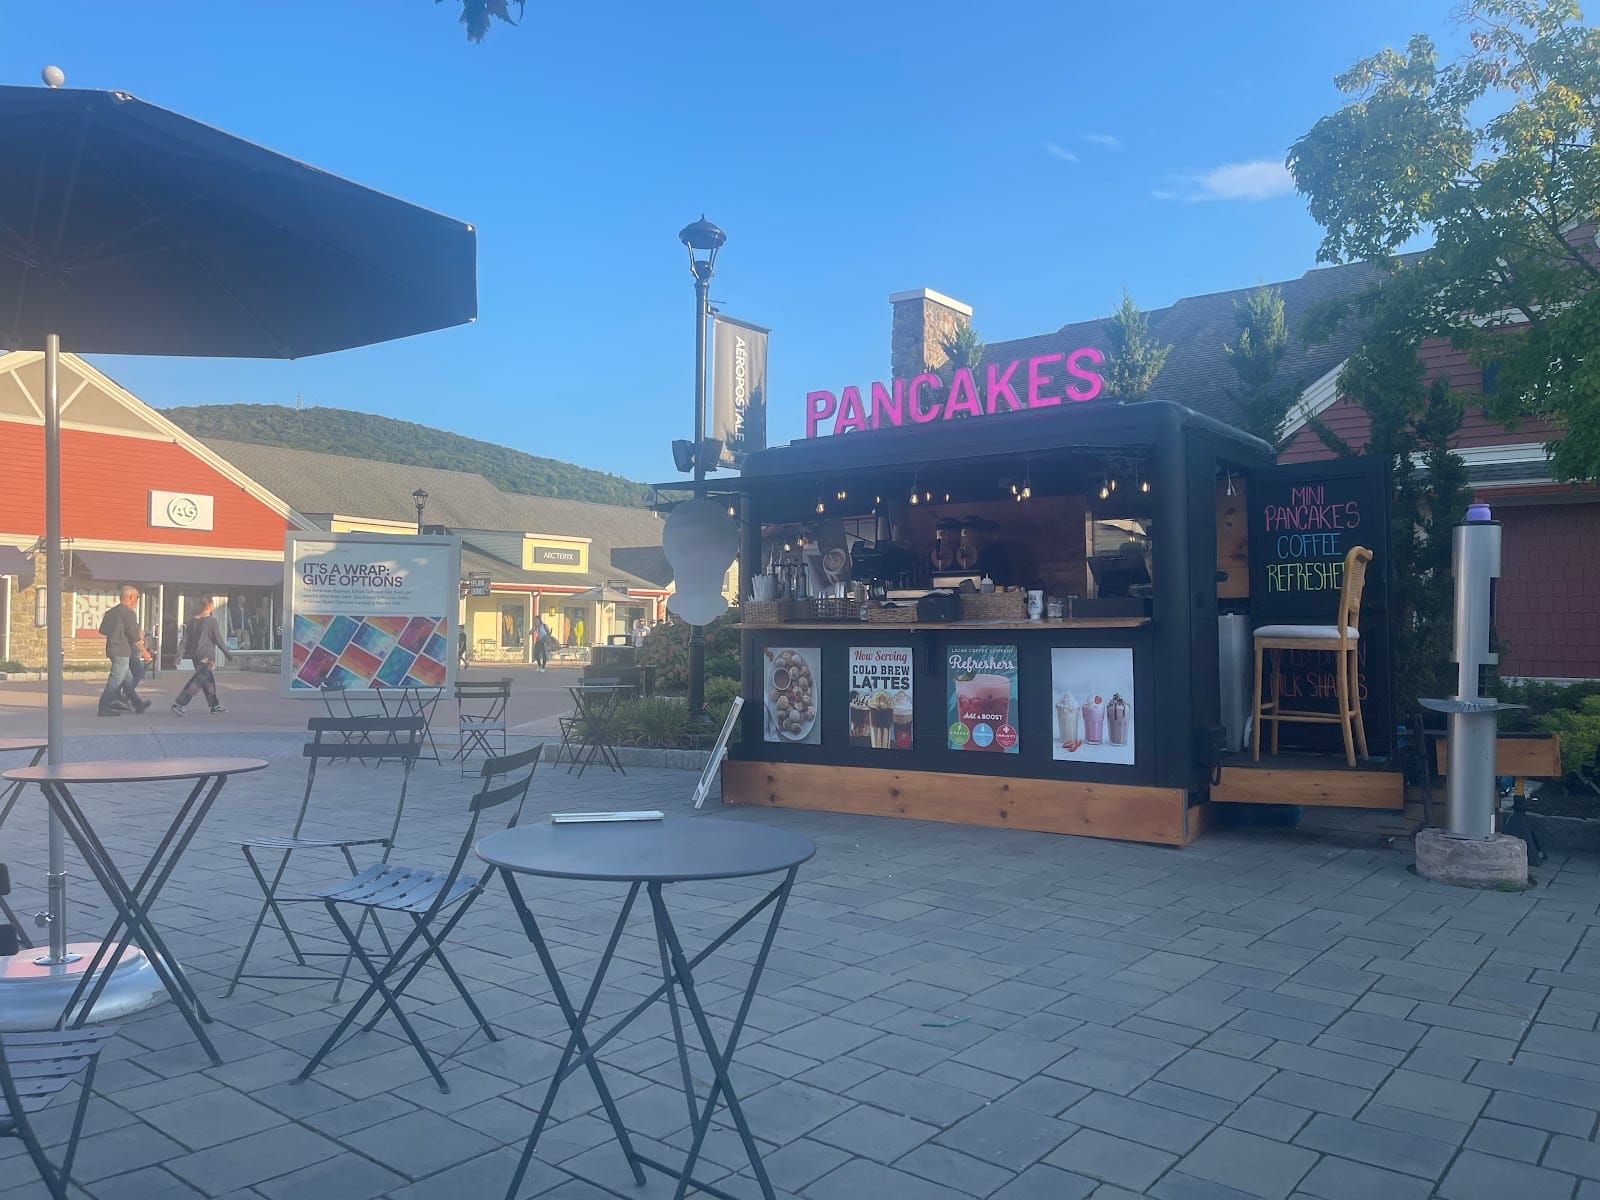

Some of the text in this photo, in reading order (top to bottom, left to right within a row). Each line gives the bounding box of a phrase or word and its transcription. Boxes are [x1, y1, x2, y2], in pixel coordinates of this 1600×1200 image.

[805, 348, 1106, 438] PANCAKES
[1292, 485, 1324, 505] MINI
[1264, 501, 1361, 532] PANCAKES
[1277, 533, 1342, 559] COFFEE
[303, 563, 390, 576] IT'S A WRAP:
[1266, 562, 1345, 592] REFRESHE
[302, 574, 403, 588] GIVE OPTIONS
[854, 650, 908, 664] Now Serving
[948, 654, 1017, 672] Refreshers
[852, 665, 910, 676] COLD BREW
[852, 676, 910, 690] LATTES
[1306, 671, 1368, 700] SHAS
